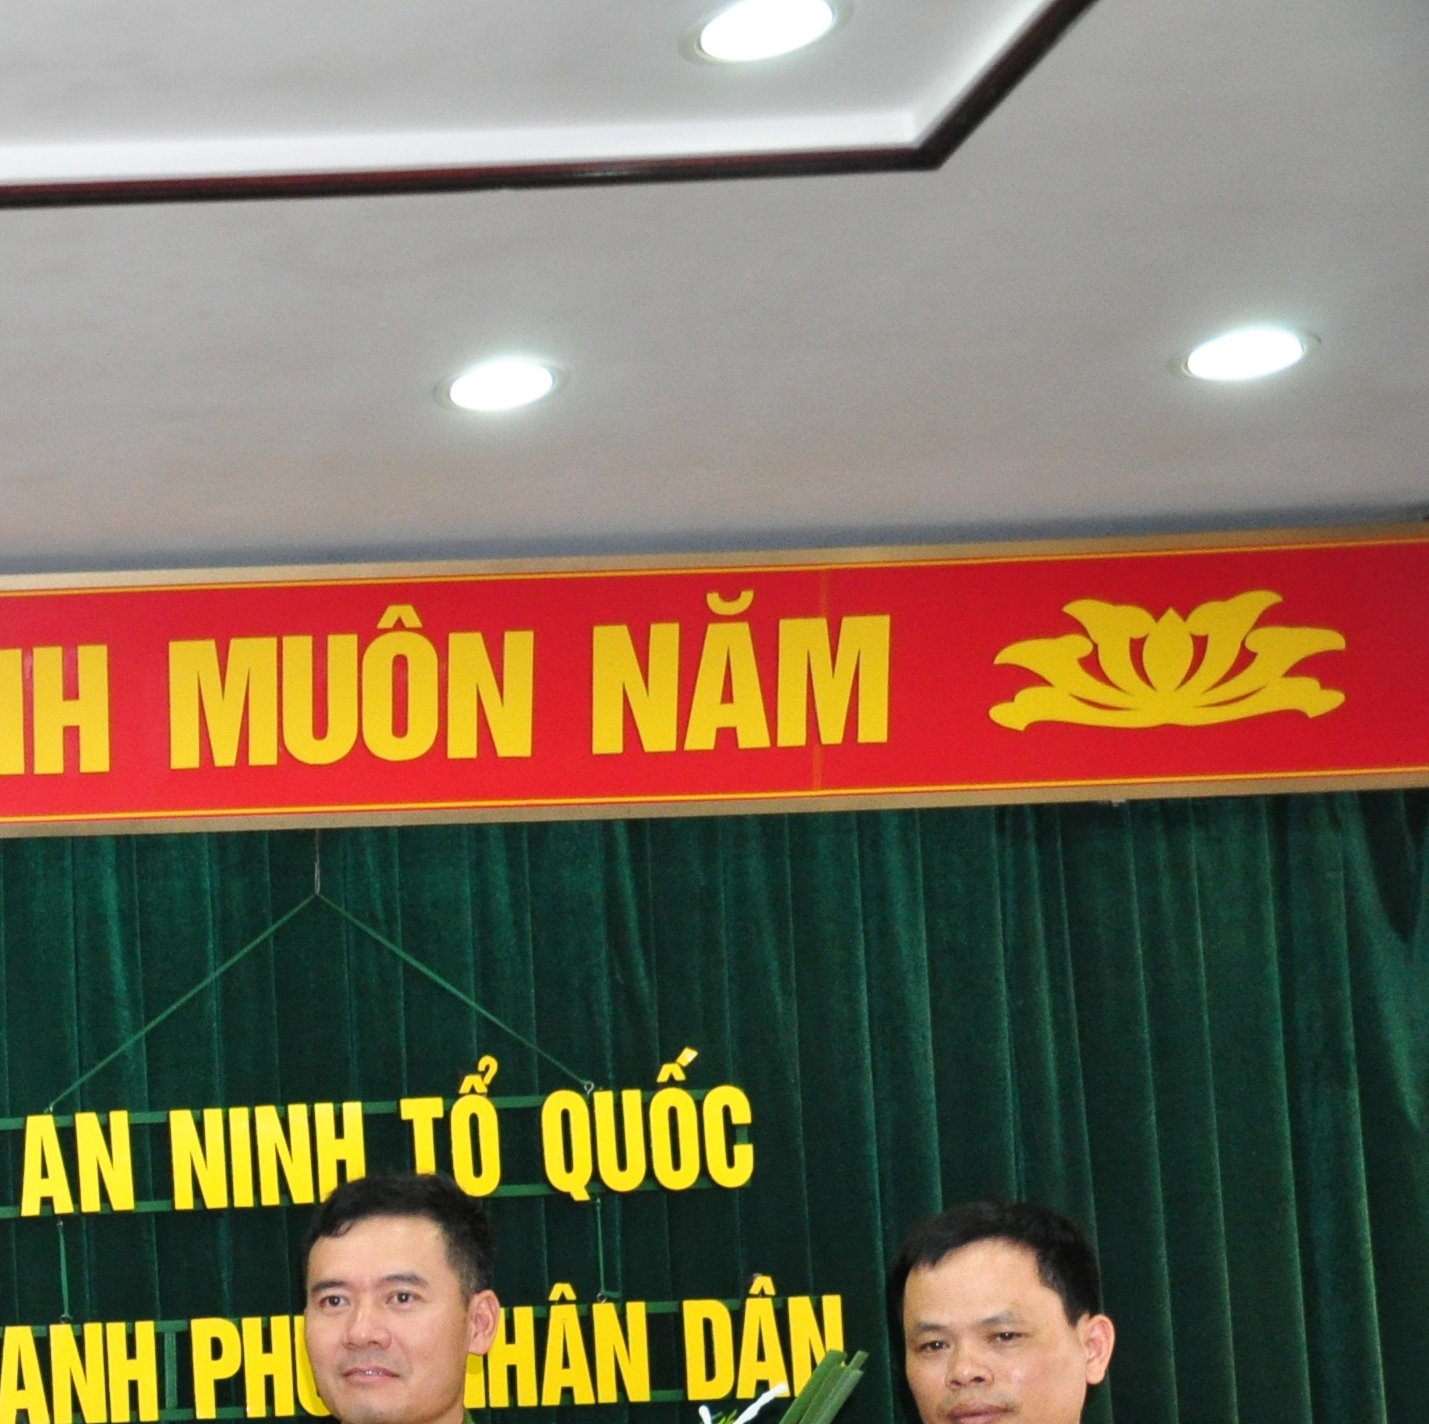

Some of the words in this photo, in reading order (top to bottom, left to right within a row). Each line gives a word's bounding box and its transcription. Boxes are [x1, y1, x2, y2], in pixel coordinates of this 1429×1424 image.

[169, 605, 535, 769] MUÔN
[592, 590, 890, 753] NĂM
[20, 1109, 135, 1217] AN
[169, 1101, 366, 1210] NINH
[399, 1055, 501, 1197] TỔ
[541, 1047, 754, 1202] QUỐC
[682, 1275, 845, 1401] DÂN
